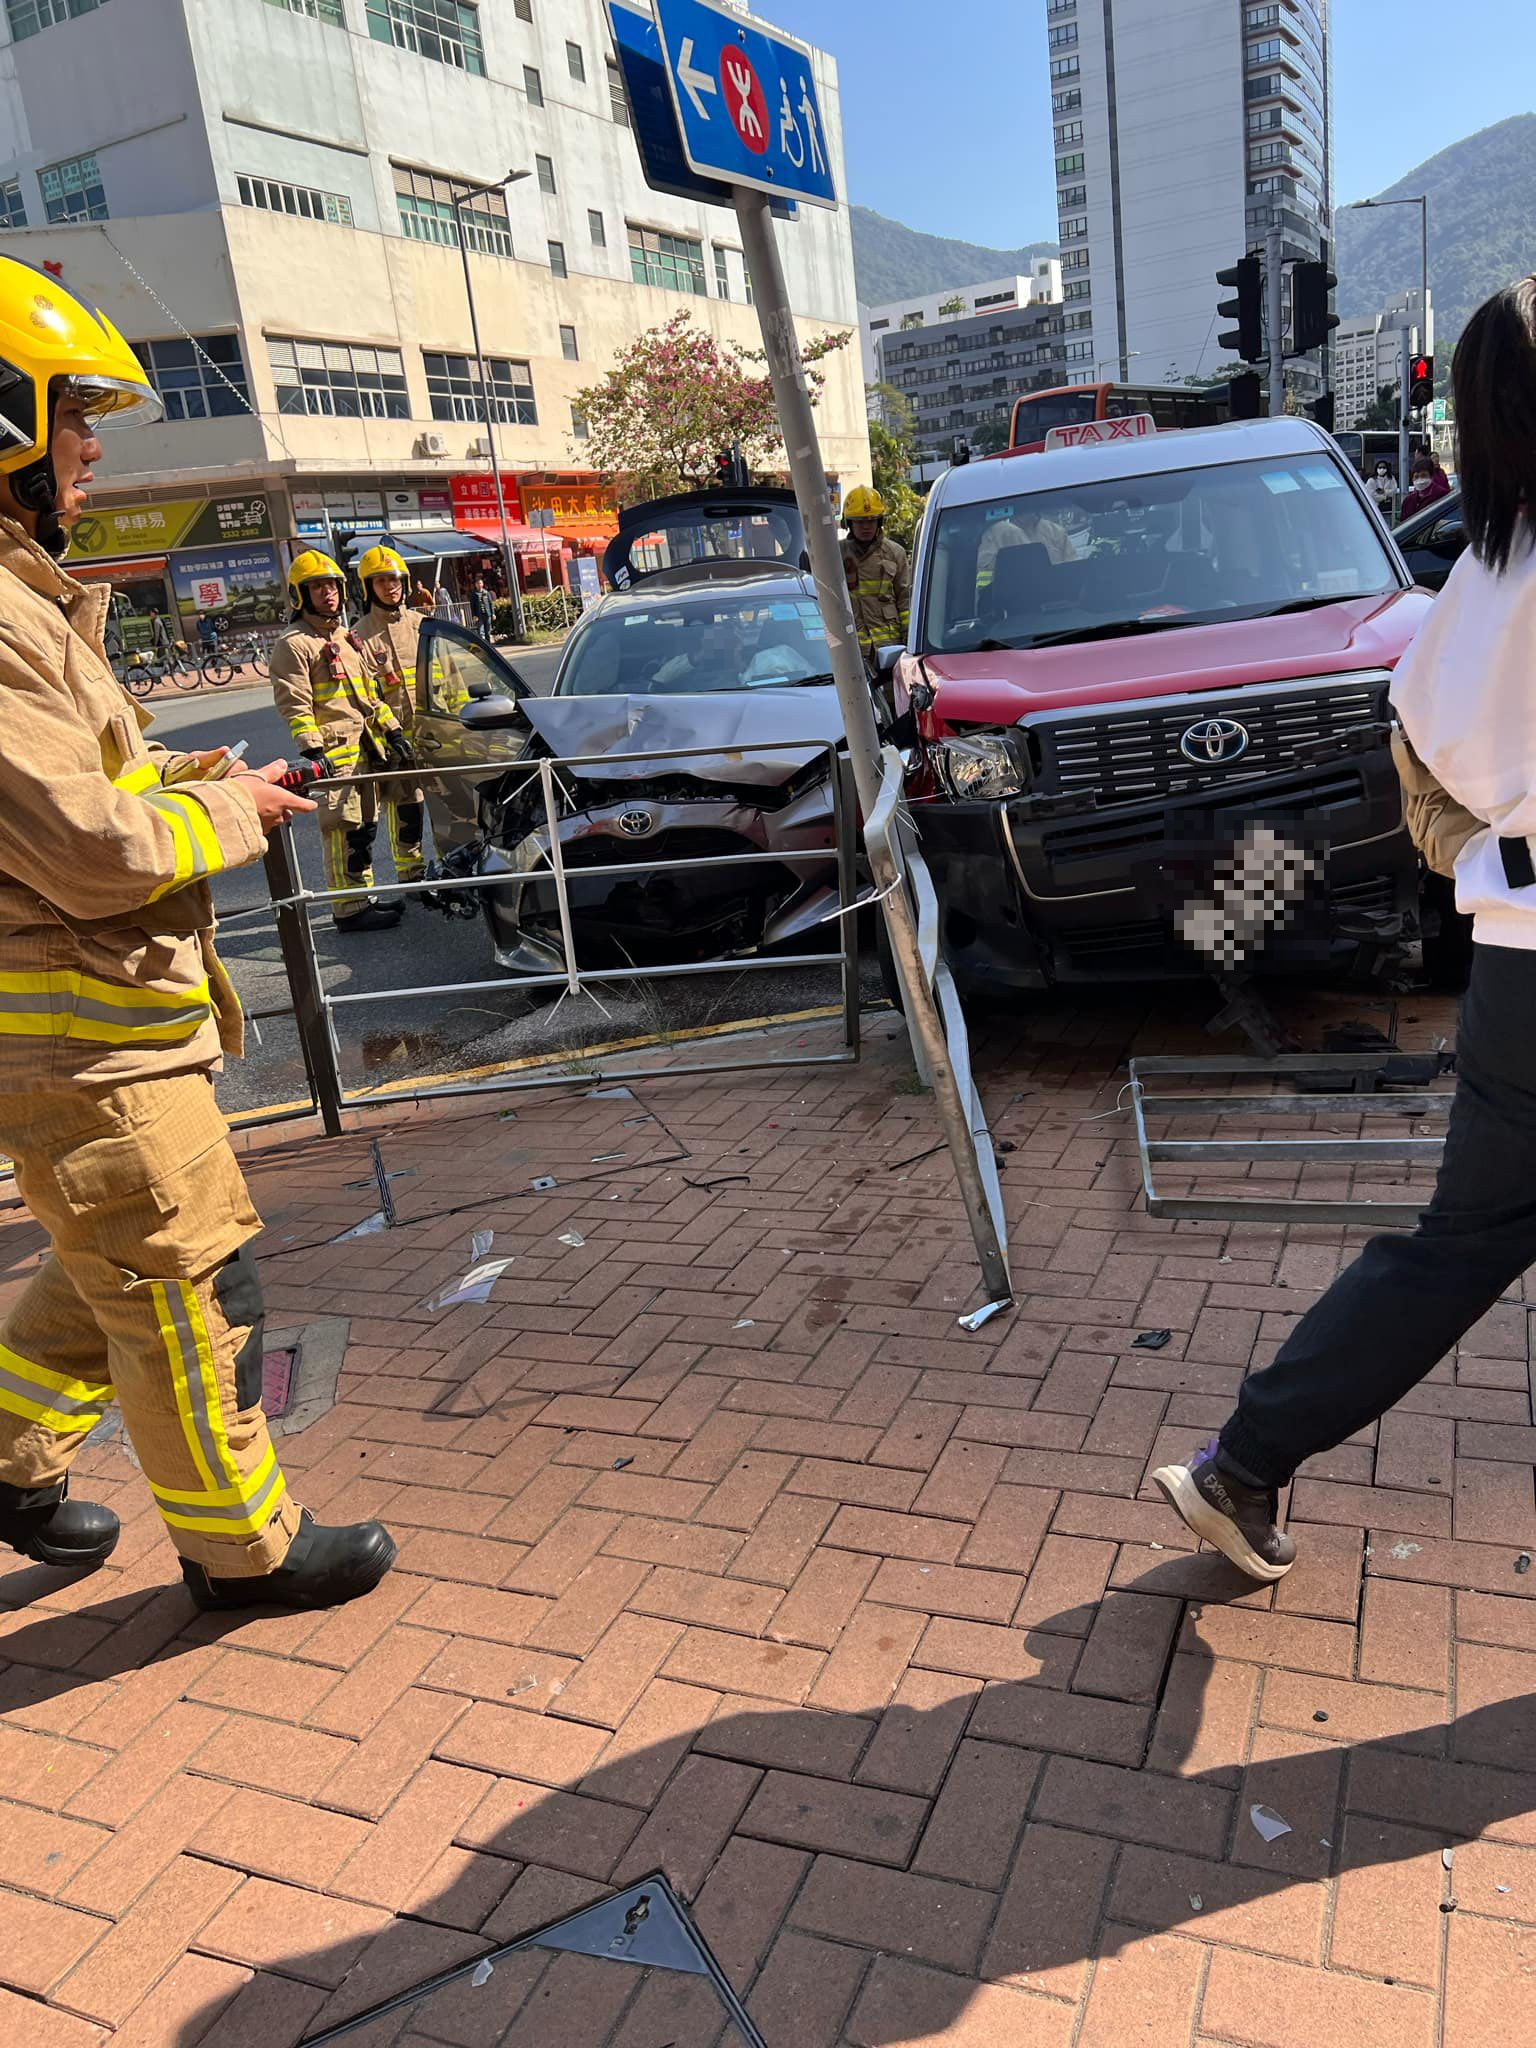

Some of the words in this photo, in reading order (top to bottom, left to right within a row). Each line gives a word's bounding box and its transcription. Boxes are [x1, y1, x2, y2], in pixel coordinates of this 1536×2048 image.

[1055, 416, 1147, 447] TAXI
[114, 511, 167, 532] 學車易
[199, 583, 224, 606] 學
